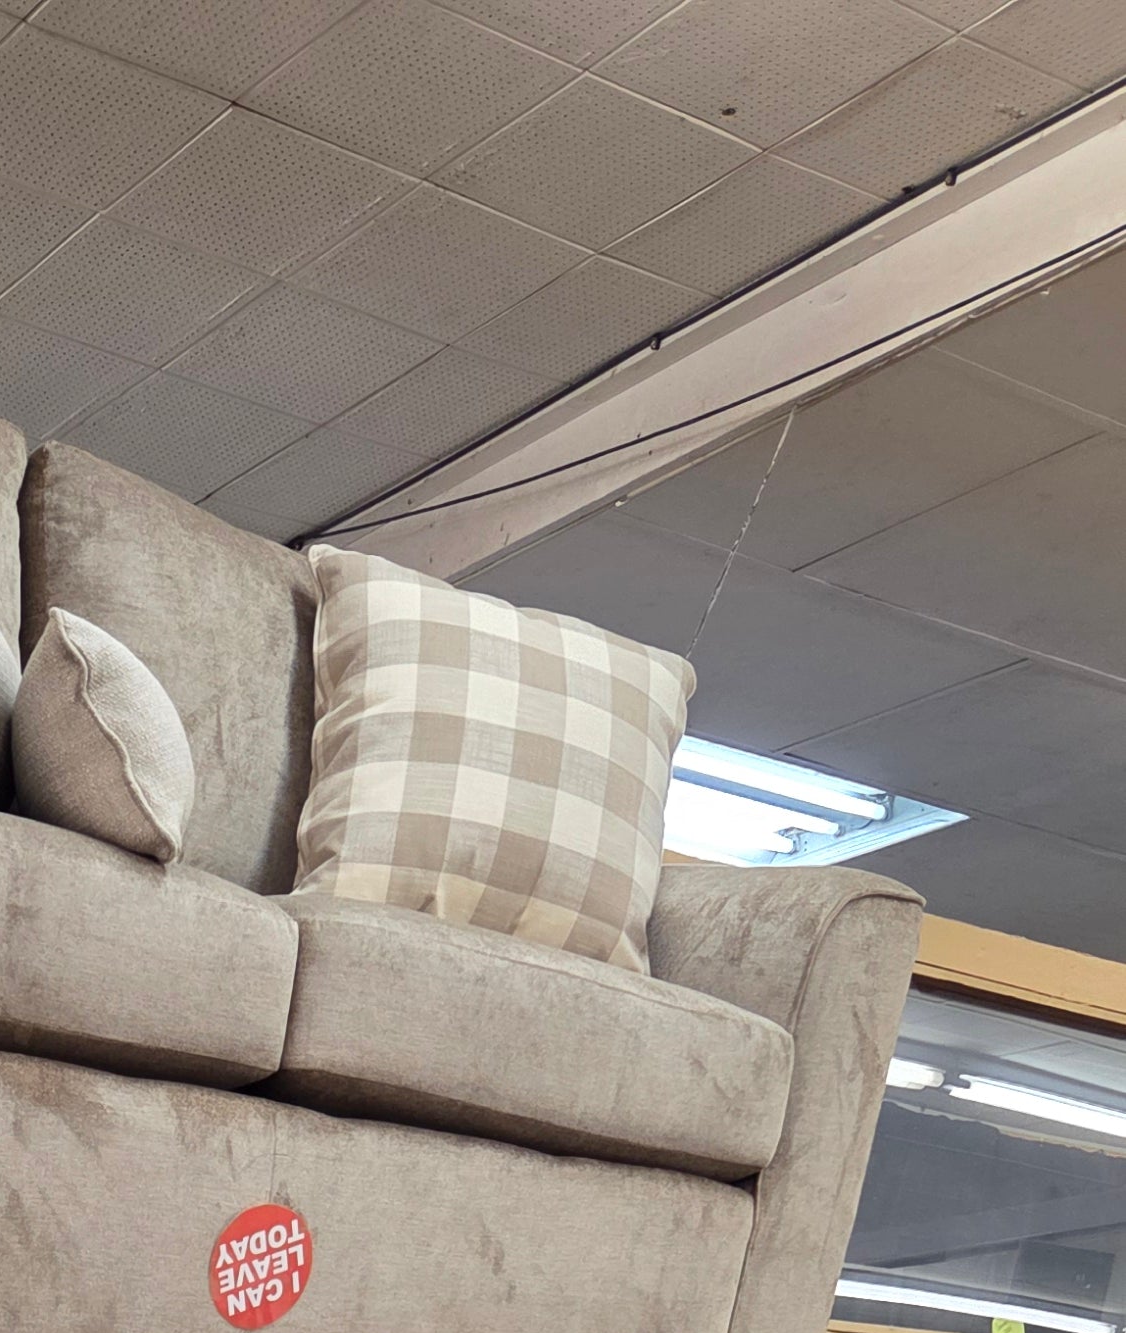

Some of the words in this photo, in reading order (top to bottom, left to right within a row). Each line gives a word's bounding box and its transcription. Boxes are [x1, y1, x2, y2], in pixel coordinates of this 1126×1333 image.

[215, 1219, 305, 1269] TODAY
[217, 1243, 305, 1294] LEAVE
[291, 1271, 300, 1294] I
[226, 1278, 283, 1317] CAN
